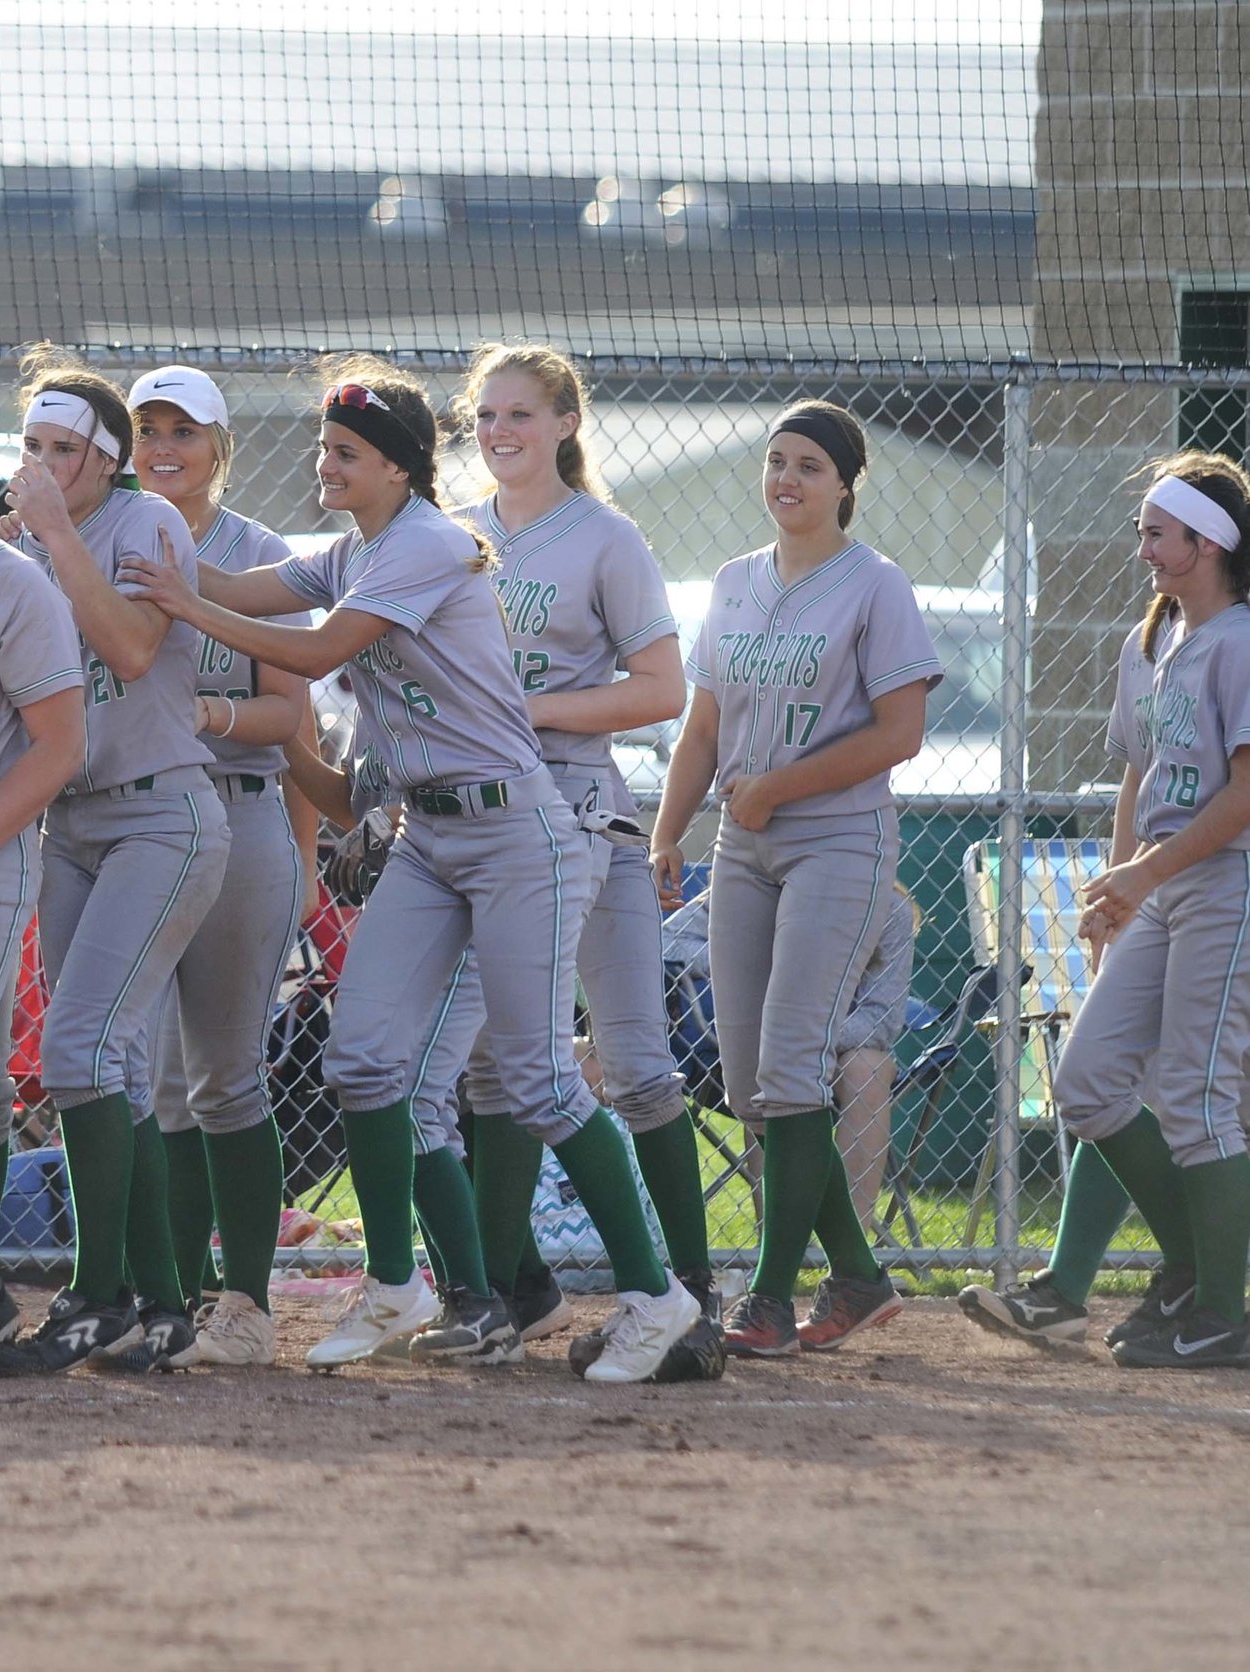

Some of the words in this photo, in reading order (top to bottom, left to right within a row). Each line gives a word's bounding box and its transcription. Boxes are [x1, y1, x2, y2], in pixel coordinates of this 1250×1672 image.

[511, 648, 551, 692] 12
[717, 631, 828, 690] TROJANS
[399, 679, 440, 719] 5
[783, 702, 823, 748] 17
[1162, 761, 1200, 809] 18
